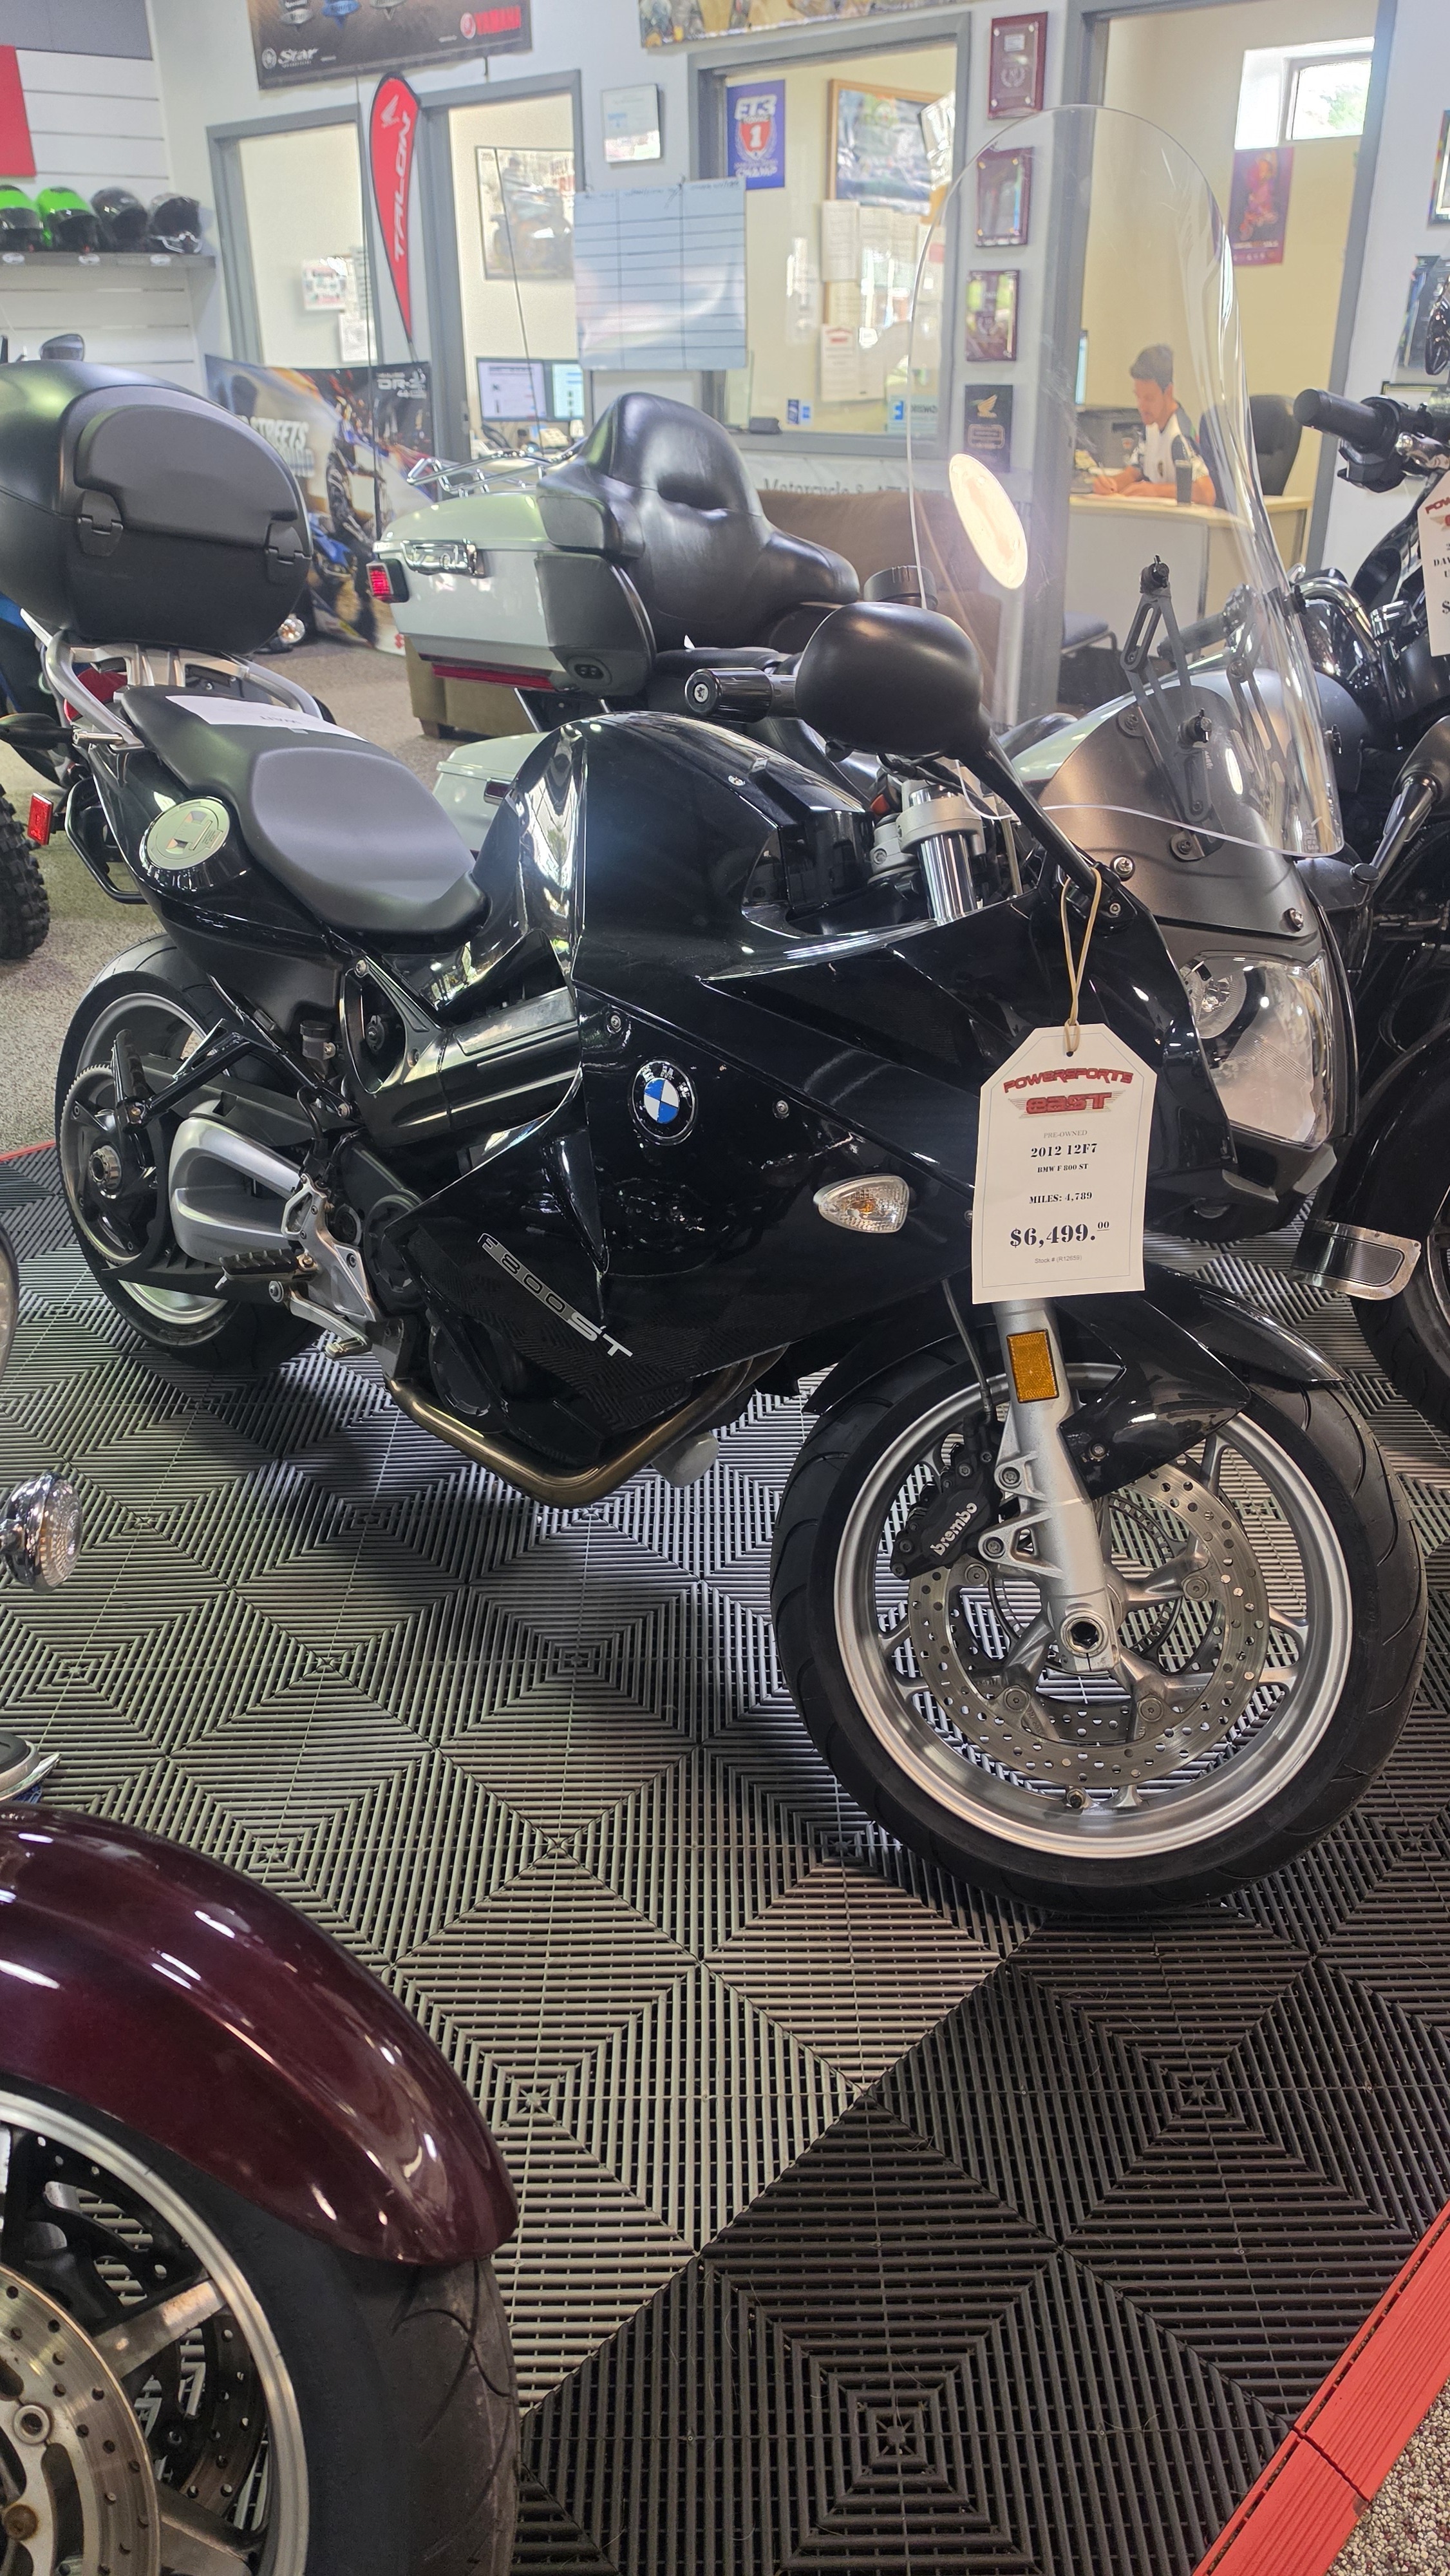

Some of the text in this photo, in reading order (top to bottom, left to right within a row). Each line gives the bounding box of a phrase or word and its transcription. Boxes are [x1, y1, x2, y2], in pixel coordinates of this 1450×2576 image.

[749, 124, 762, 148] 1
[394, 109, 411, 262] TALON
[1003, 1067, 1134, 1093] POWERSPORTS
[1043, 1130, 1088, 1139] PRE-OWNED
[1030, 1142, 1098, 1158] 2012 12F7
[1029, 1191, 1093, 1204] MILES: 4,789
[930, 1502, 977, 1556] brembo
